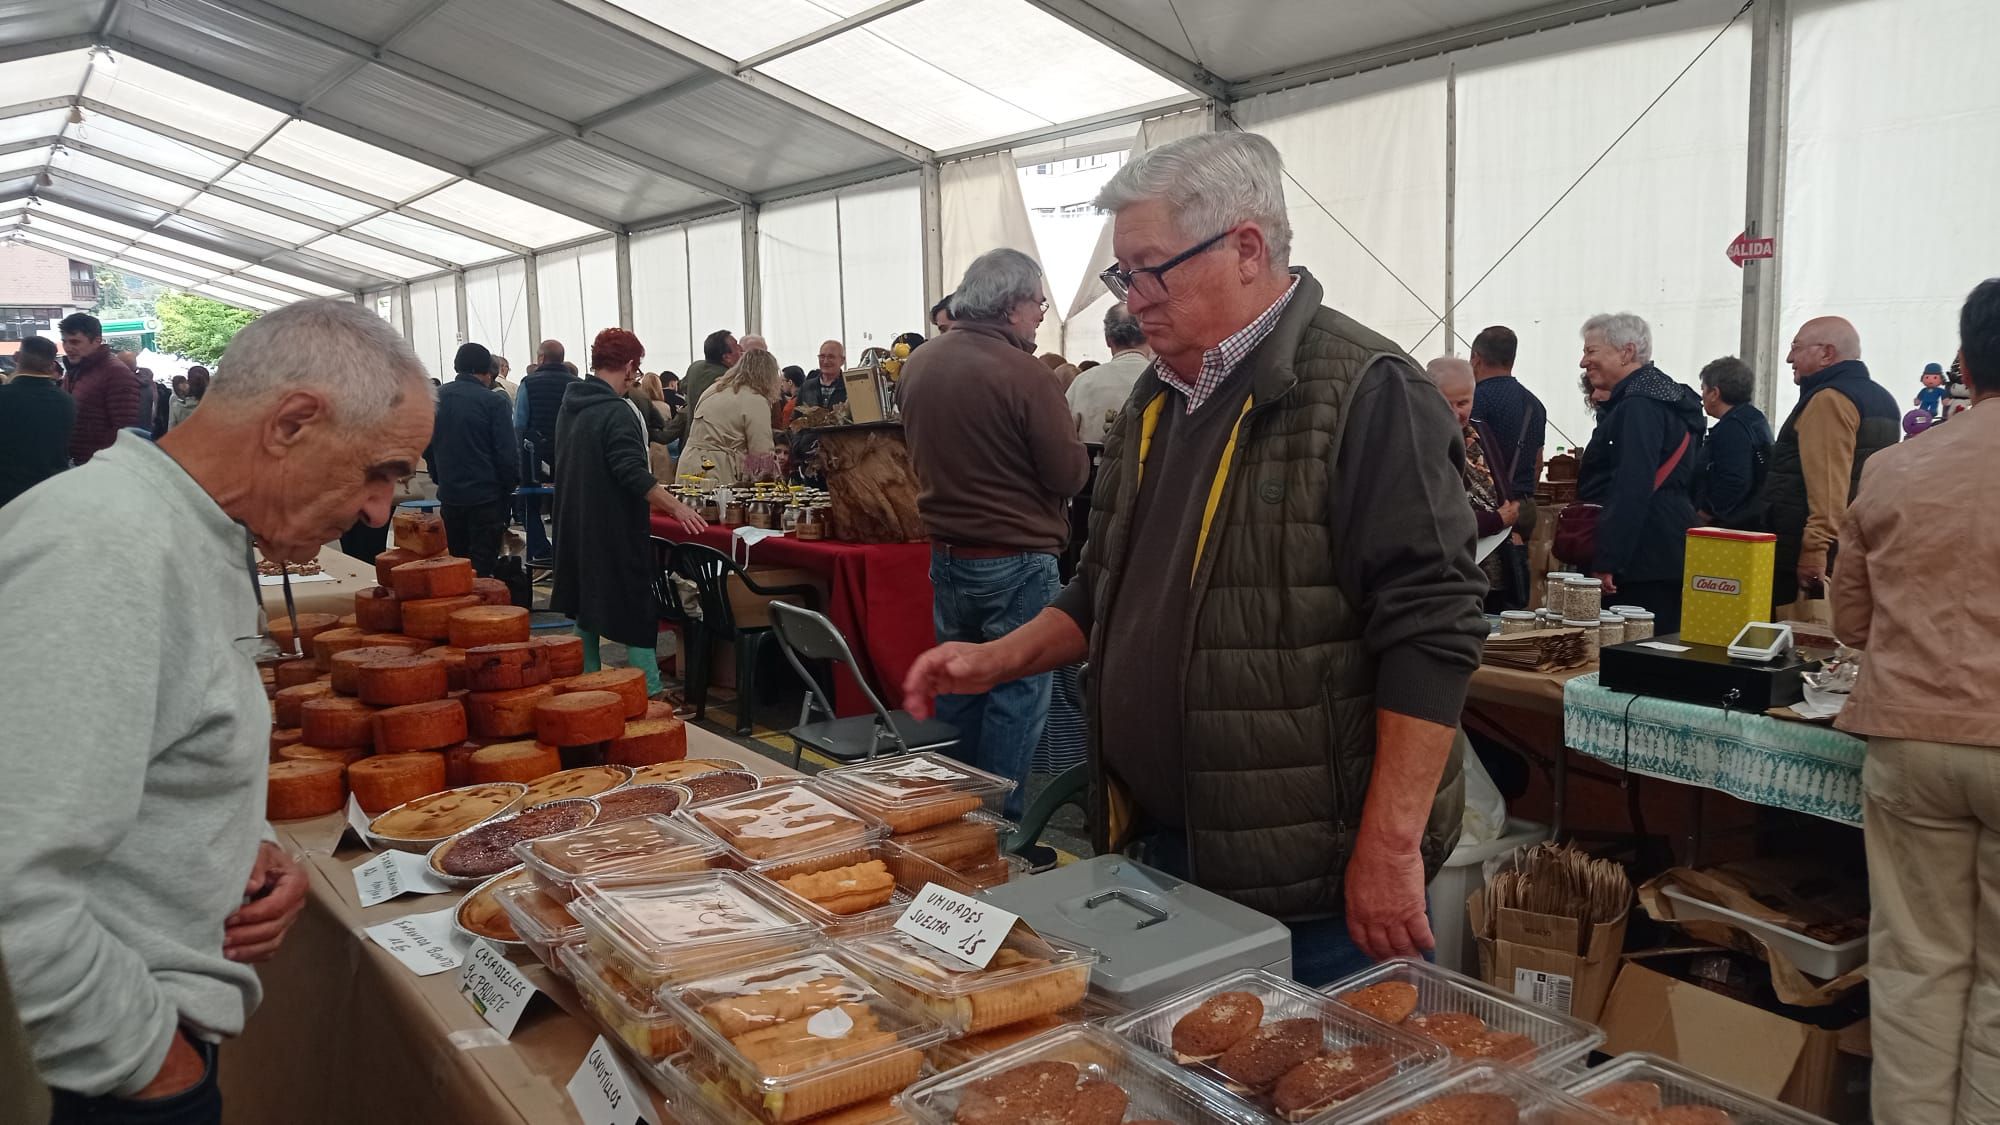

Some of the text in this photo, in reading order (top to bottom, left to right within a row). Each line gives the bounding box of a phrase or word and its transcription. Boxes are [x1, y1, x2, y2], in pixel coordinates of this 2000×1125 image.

[1697, 579, 1736, 592] Cola Cao
[910, 909, 951, 936] SUELTAS
[926, 892, 984, 924] UNIDADES
[475, 947, 527, 997] CASADIELLES
[473, 975, 511, 1013] PAQUETE
